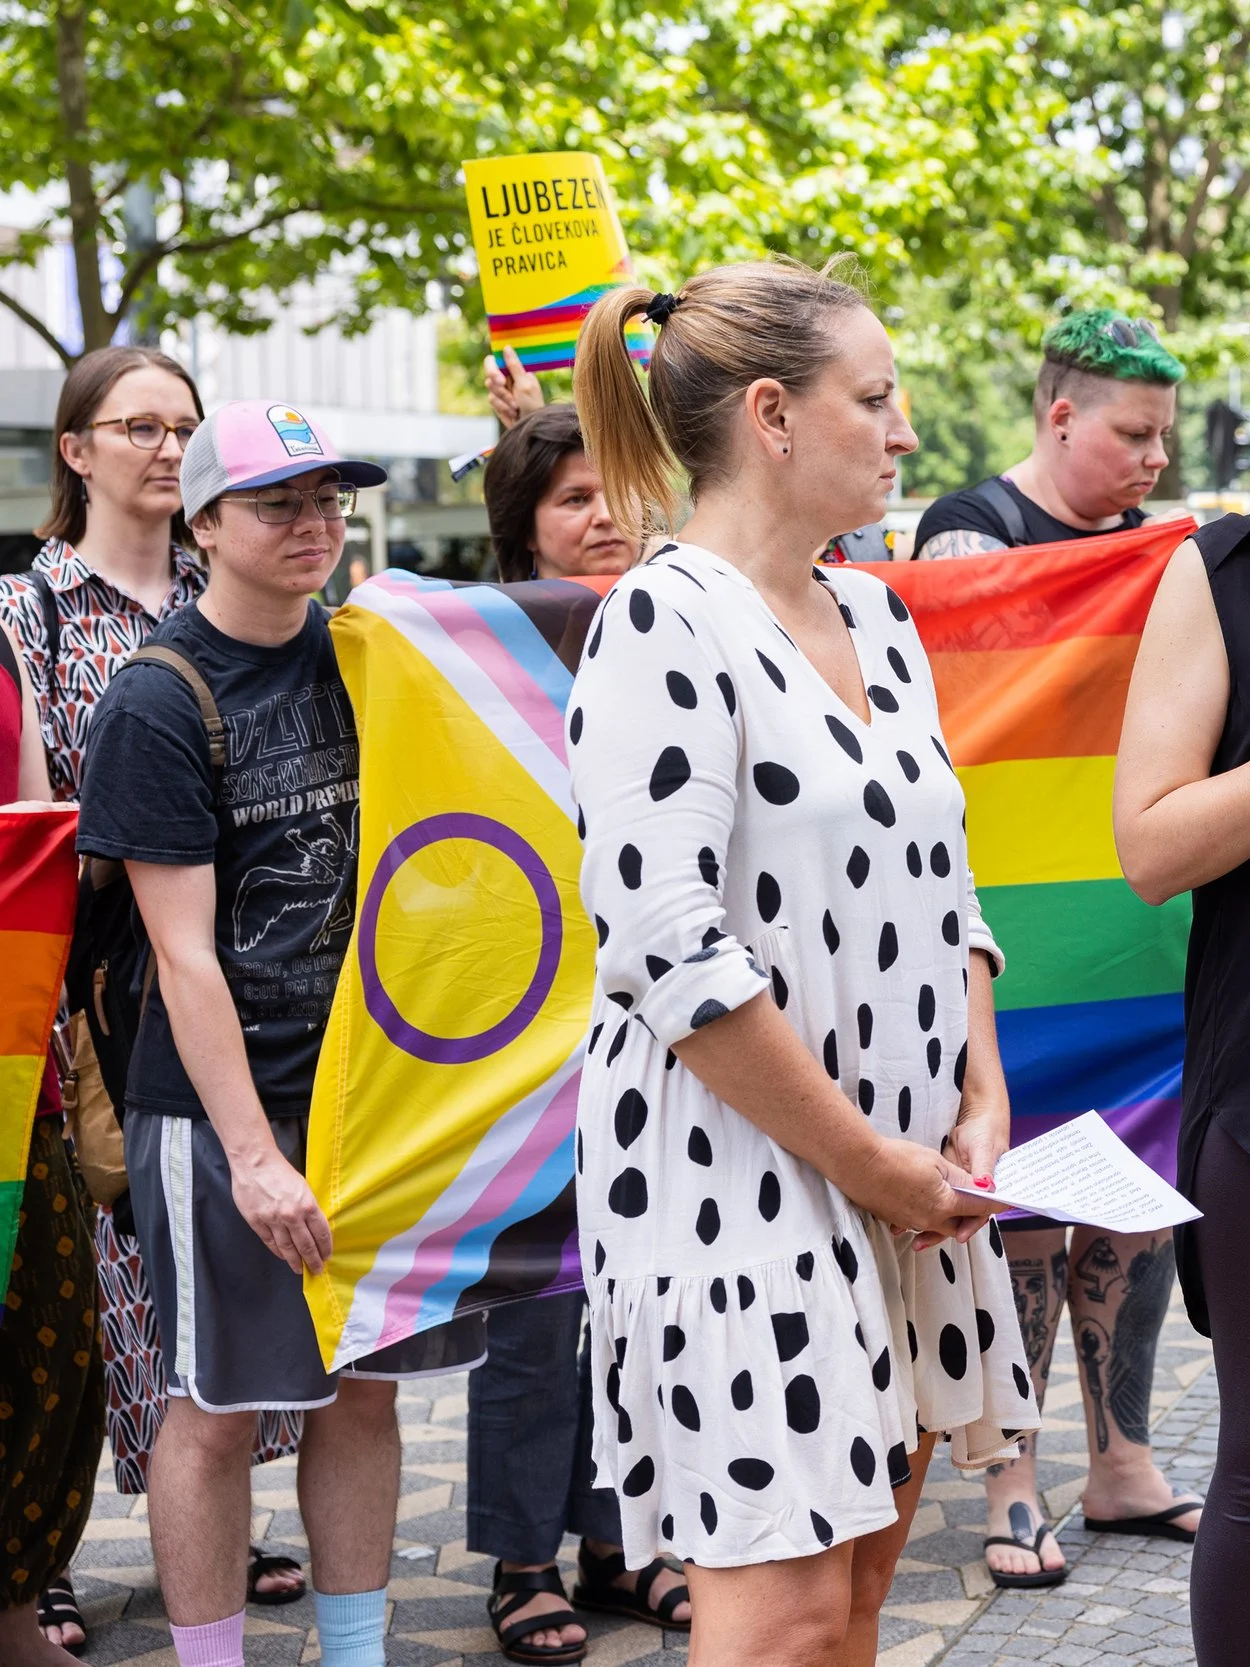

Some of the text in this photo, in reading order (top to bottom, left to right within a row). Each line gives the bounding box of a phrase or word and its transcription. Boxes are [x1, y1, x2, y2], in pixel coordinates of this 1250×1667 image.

[488, 219, 600, 248] JE ČLOVEKOVA
[492, 250, 567, 276] PRAVICA
[232, 794, 304, 828] WORLD
[243, 982, 280, 1000] 8:00
[284, 979, 309, 998] PM
